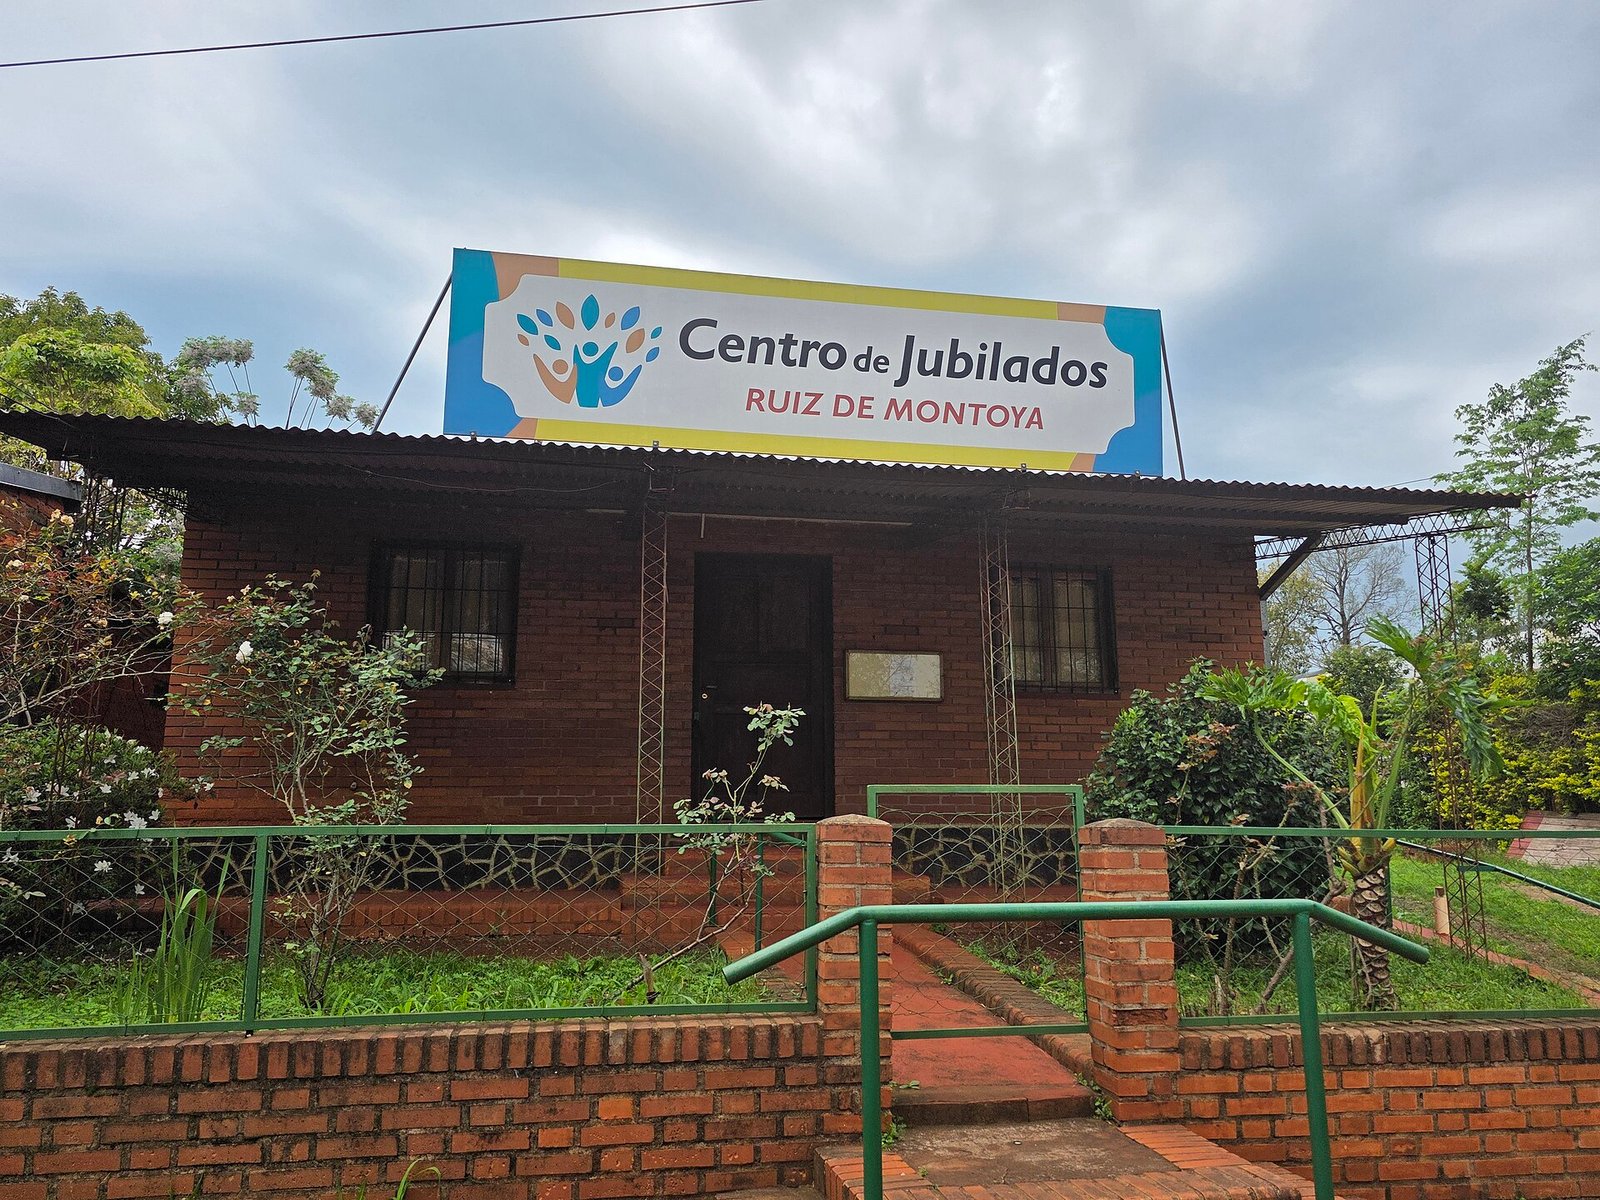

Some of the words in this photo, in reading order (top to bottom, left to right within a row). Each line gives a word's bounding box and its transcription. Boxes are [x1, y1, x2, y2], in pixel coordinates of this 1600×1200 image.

[679, 317, 847, 371] Centro
[853, 345, 890, 374] de
[893, 334, 1109, 389] Jubilados
[745, 387, 825, 417] RUIZ
[832, 393, 875, 420] DE
[884, 397, 1044, 430] MONTOYA
